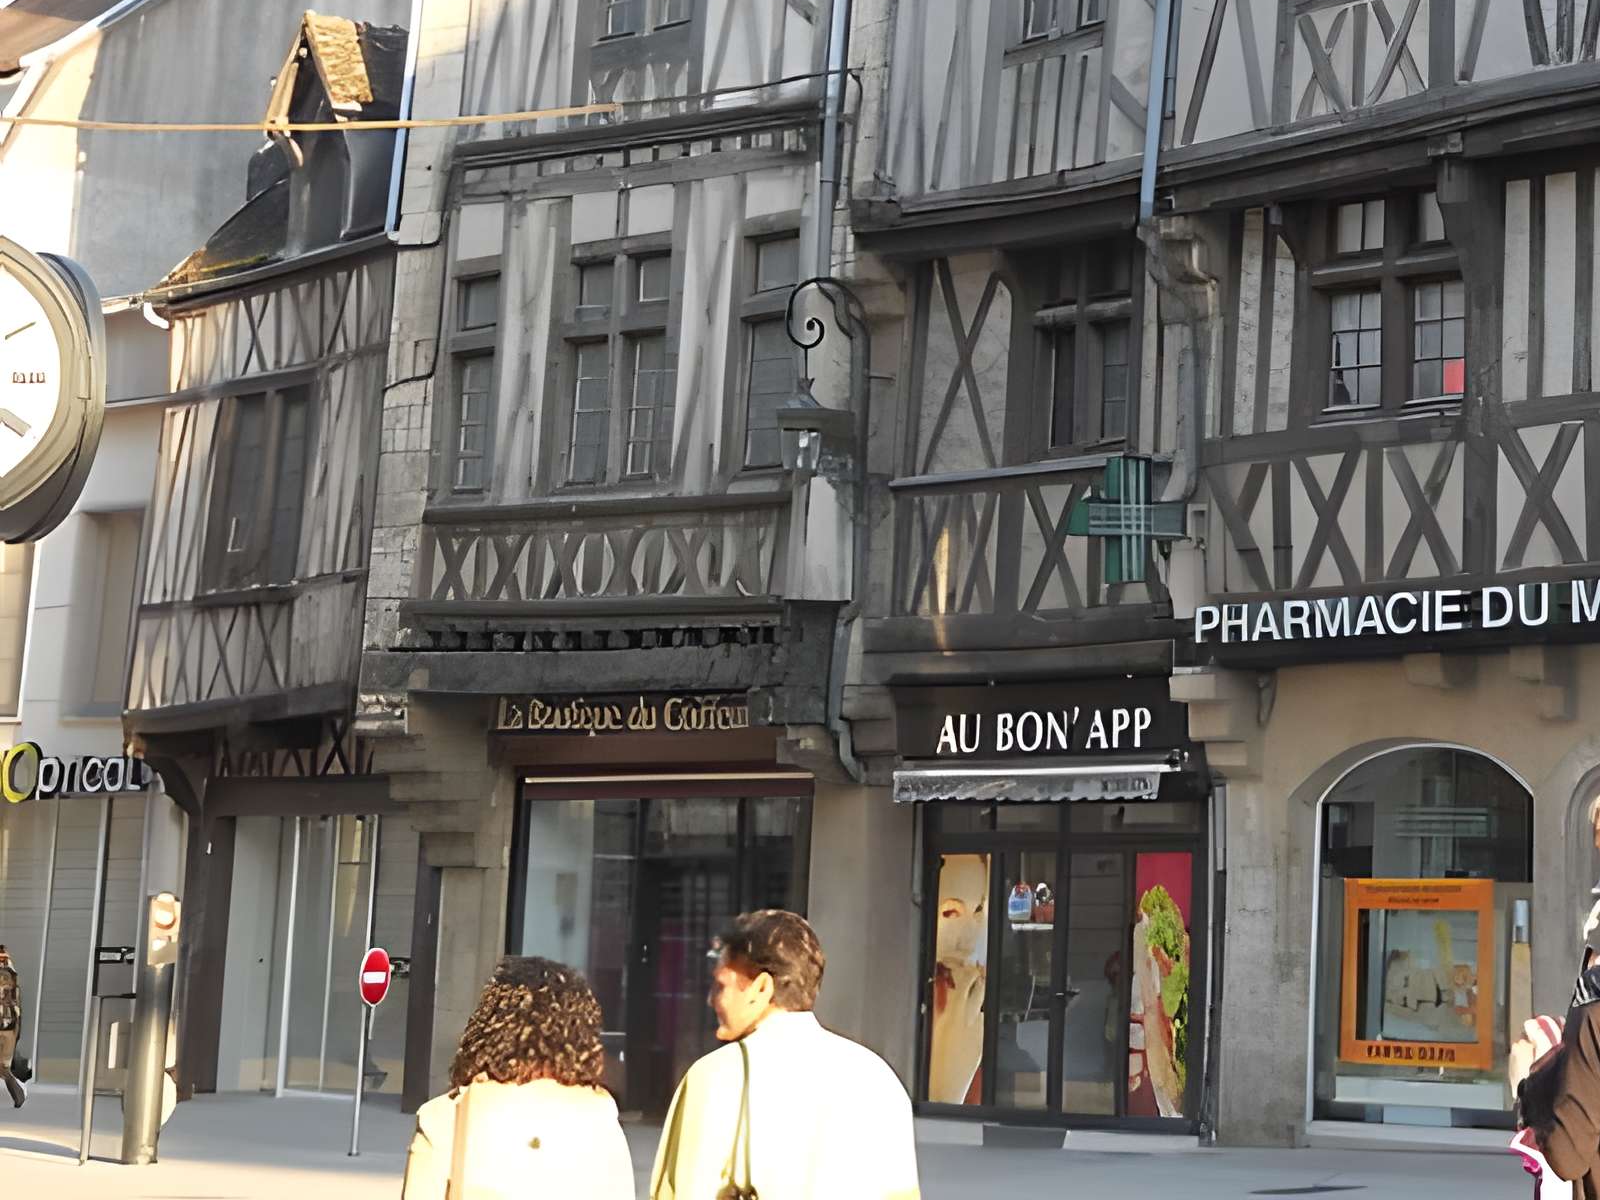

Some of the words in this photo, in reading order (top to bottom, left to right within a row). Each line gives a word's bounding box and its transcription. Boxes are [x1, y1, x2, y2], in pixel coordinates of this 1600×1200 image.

[1194, 589, 1464, 644] PHARMACIE
[1482, 582, 1549, 629] DU
[936, 713, 981, 755] AU
